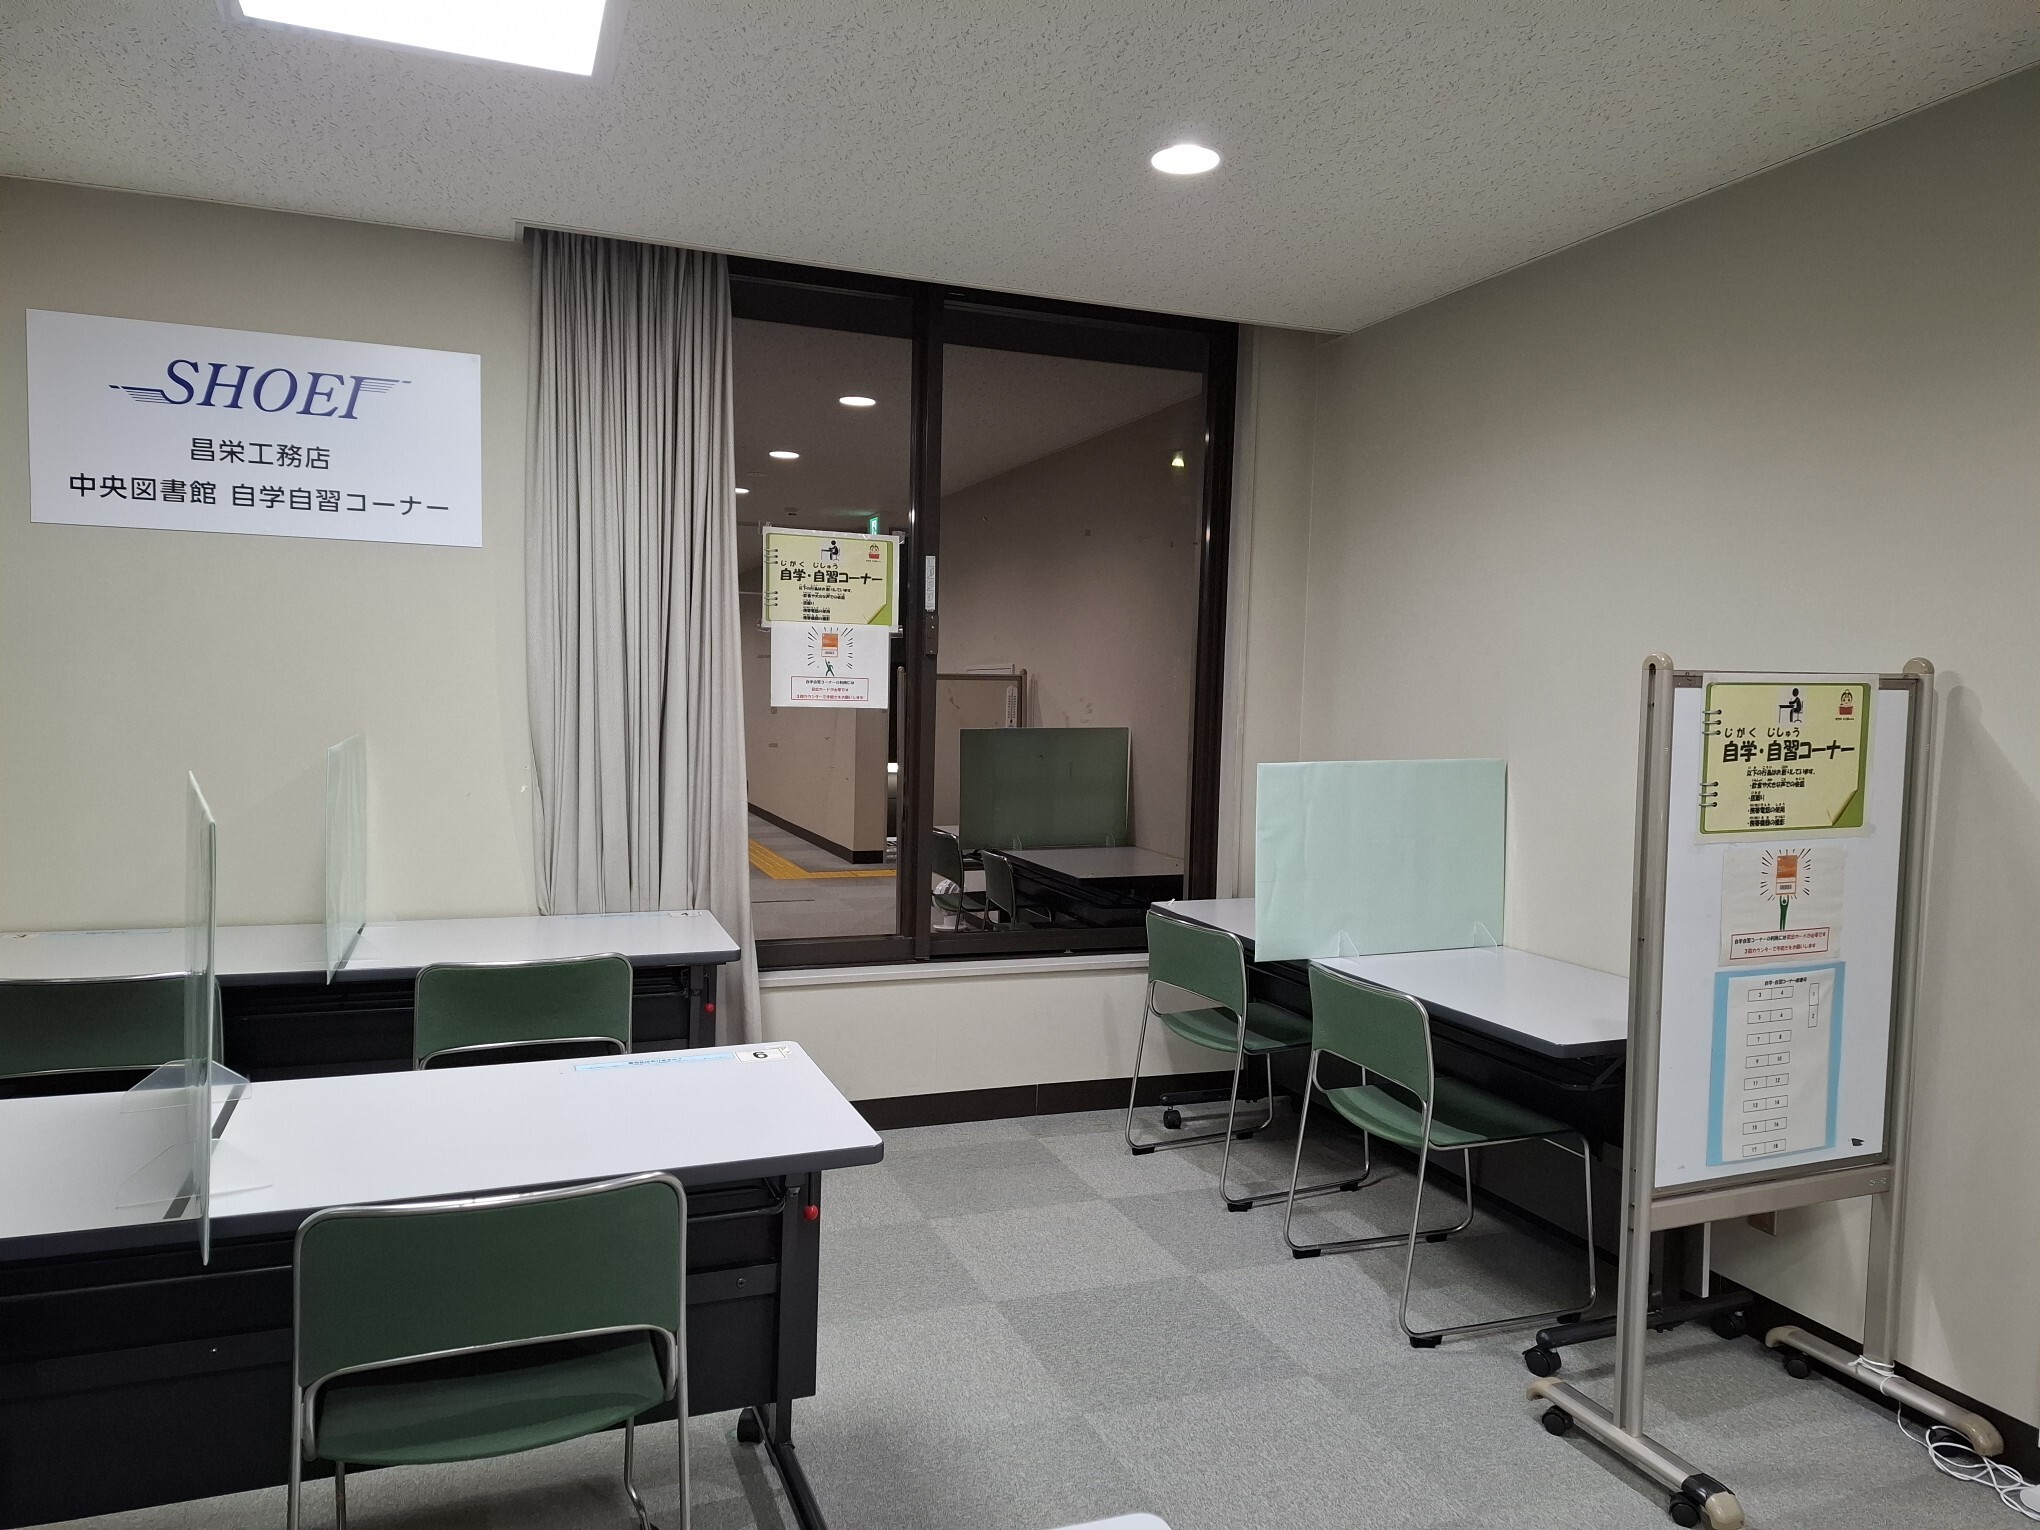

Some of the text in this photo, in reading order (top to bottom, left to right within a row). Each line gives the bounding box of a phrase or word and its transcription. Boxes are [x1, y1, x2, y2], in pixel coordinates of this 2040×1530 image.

[162, 359, 372, 420] SHOEI
[190, 437, 331, 470] 昌栄工務店
[69, 472, 449, 516] 中央図書館 自学自習コーナー
[780, 567, 883, 585] 自学・自習コーナー
[1724, 727, 1800, 738] じがく じしゅう
[1722, 739, 1855, 763] 自学・自習コーナー
[752, 1051, 769, 1059] 6
